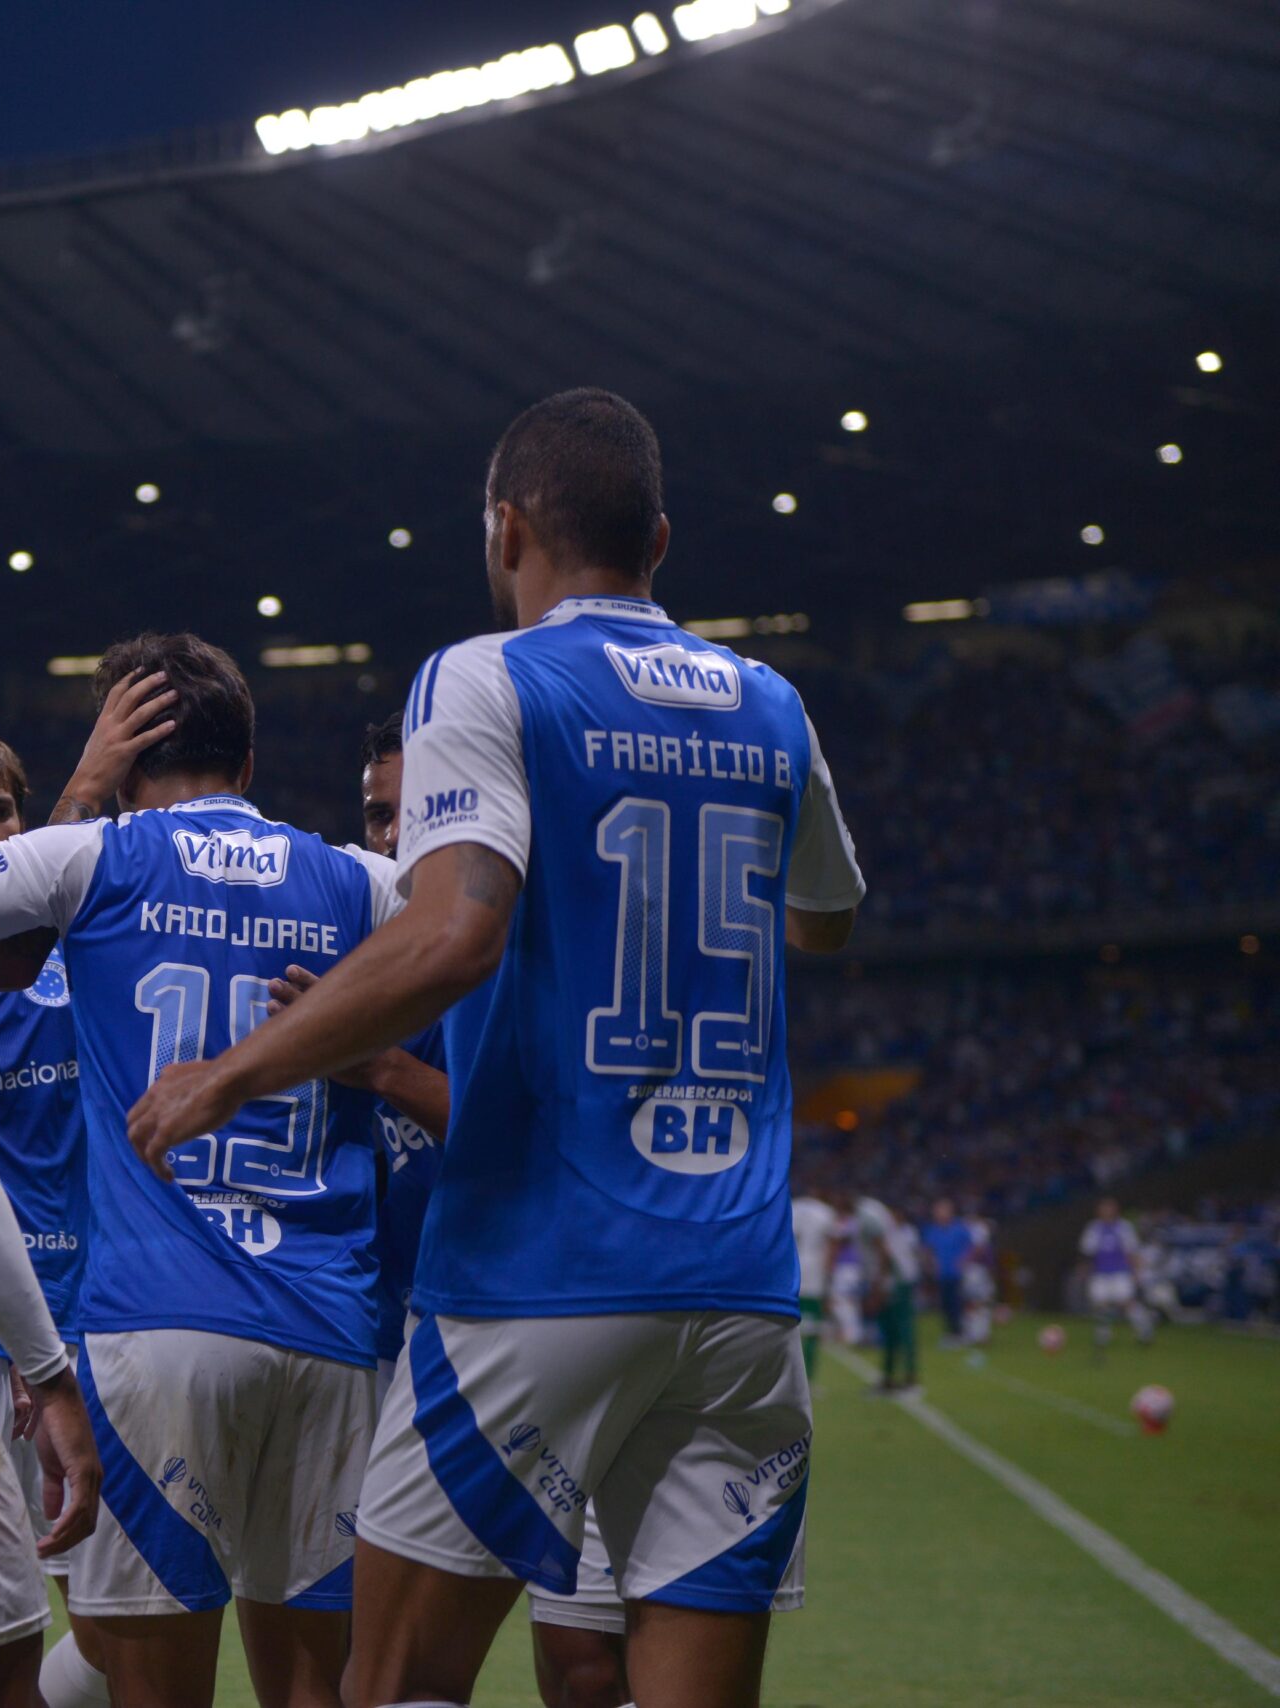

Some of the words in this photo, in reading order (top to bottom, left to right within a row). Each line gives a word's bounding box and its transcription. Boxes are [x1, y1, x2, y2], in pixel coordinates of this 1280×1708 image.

[617, 651, 732, 695] Vilma
[584, 730, 765, 784] FABRÍCIO
[184, 836, 278, 875] Vilma
[140, 901, 227, 940] KAIO
[231, 916, 339, 956] JORGE
[585, 797, 784, 1083] 15
[651, 1104, 735, 1155] BH
[22, 1230, 78, 1250] DIGÃO
[199, 1208, 265, 1245] BH
[540, 1447, 587, 1514] VITÓRI
[746, 1434, 810, 1486] VITÓRI
[539, 1475, 572, 1513] CUP
